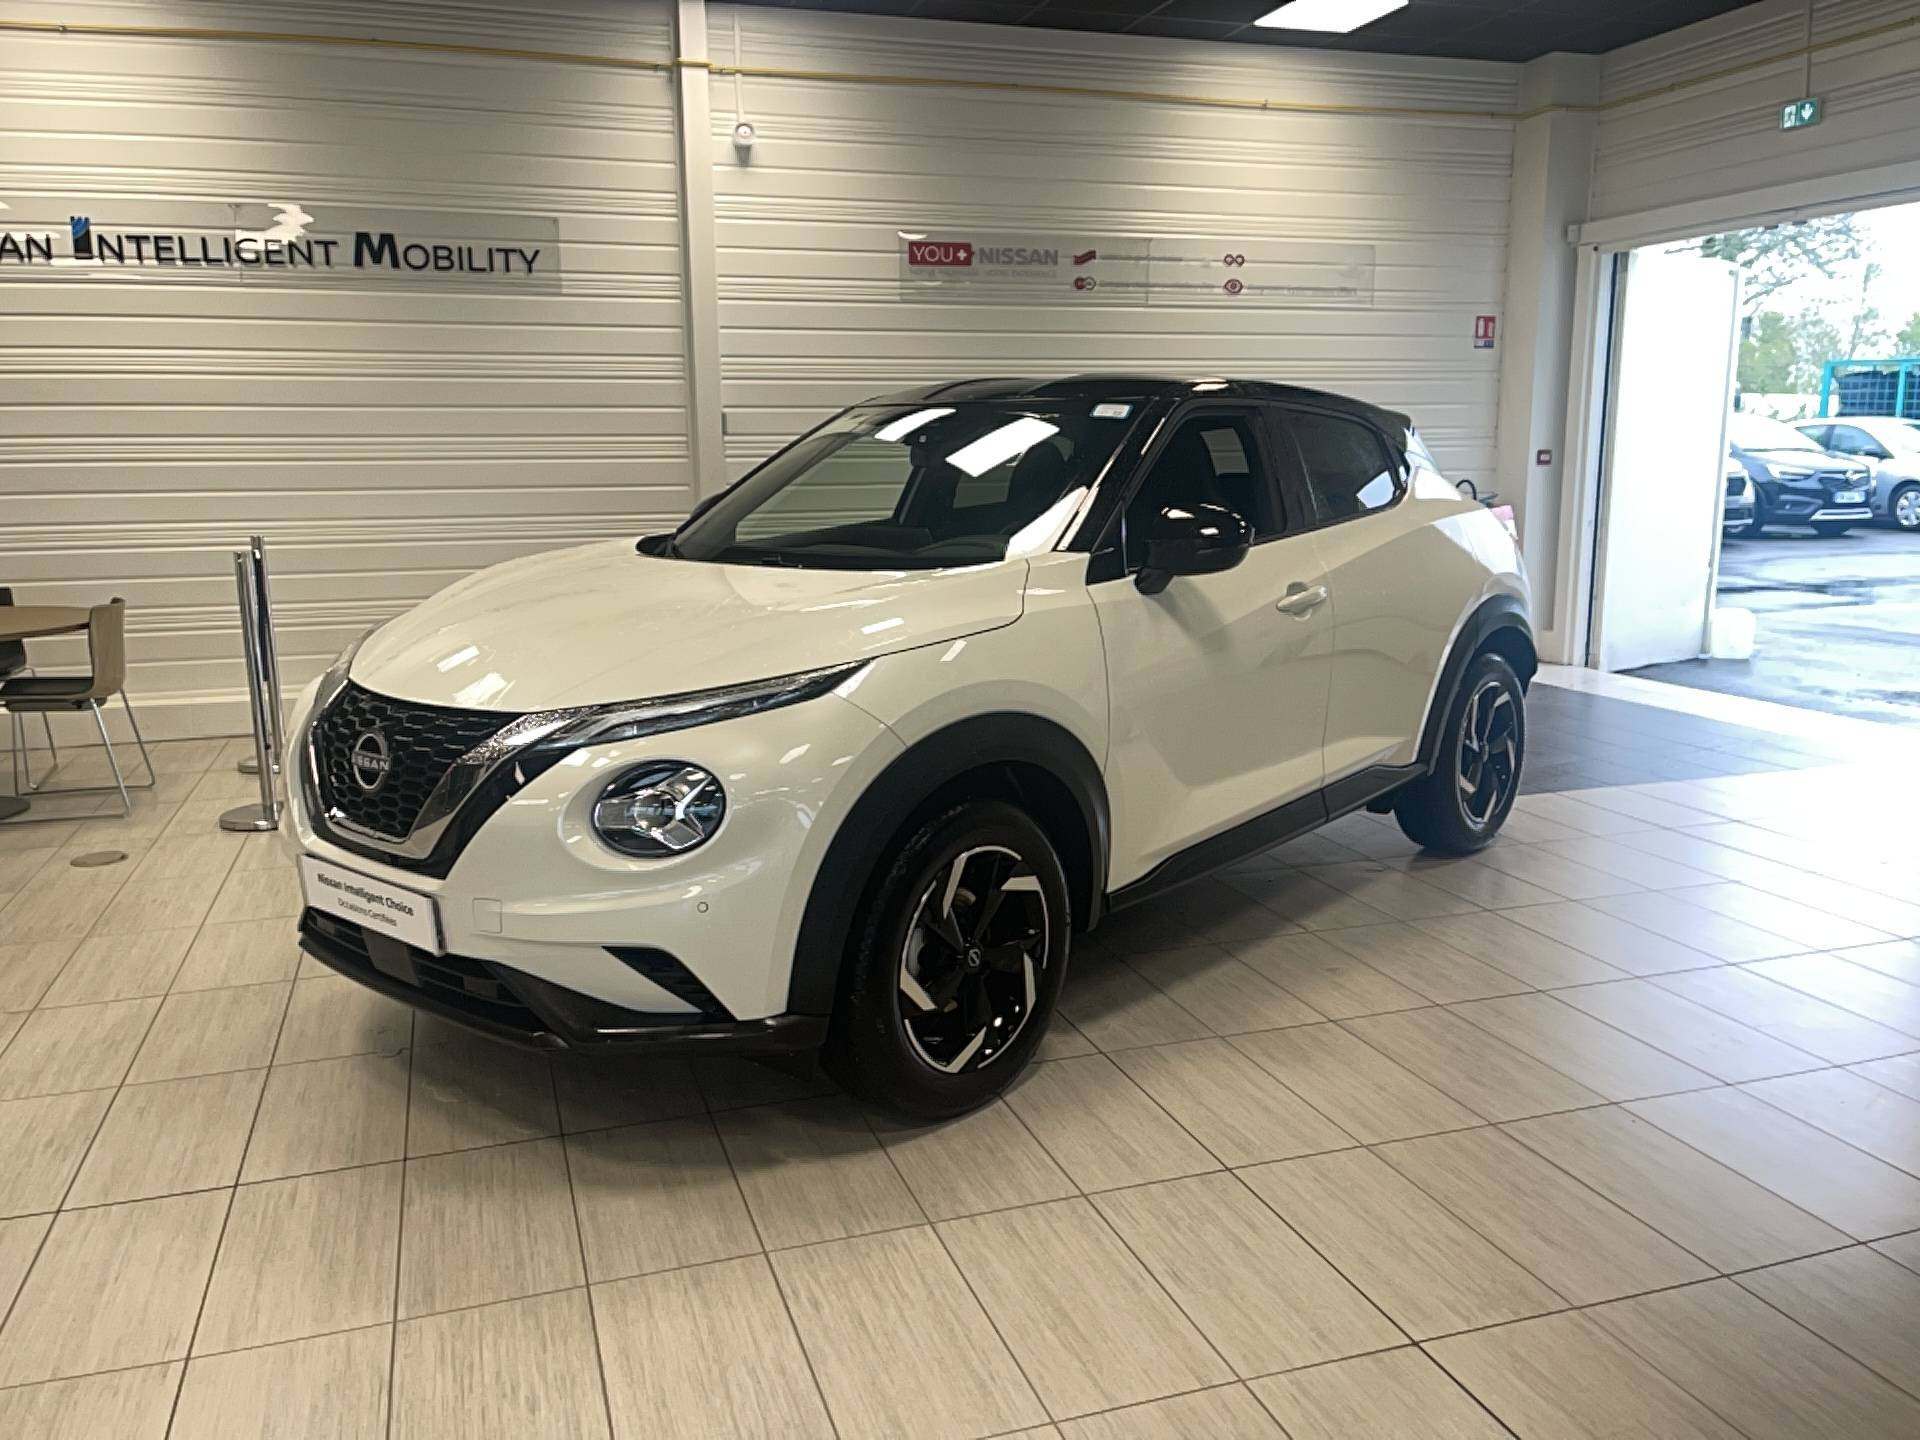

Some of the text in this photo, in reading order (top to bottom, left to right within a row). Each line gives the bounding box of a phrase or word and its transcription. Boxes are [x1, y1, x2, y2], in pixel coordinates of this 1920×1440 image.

[70, 216, 339, 268] INTELLIGENT
[353, 232, 541, 274] MOBILITY
[978, 247, 1059, 266] NISSAN
[317, 872, 343, 891] Nissan
[385, 896, 415, 917] Choice
